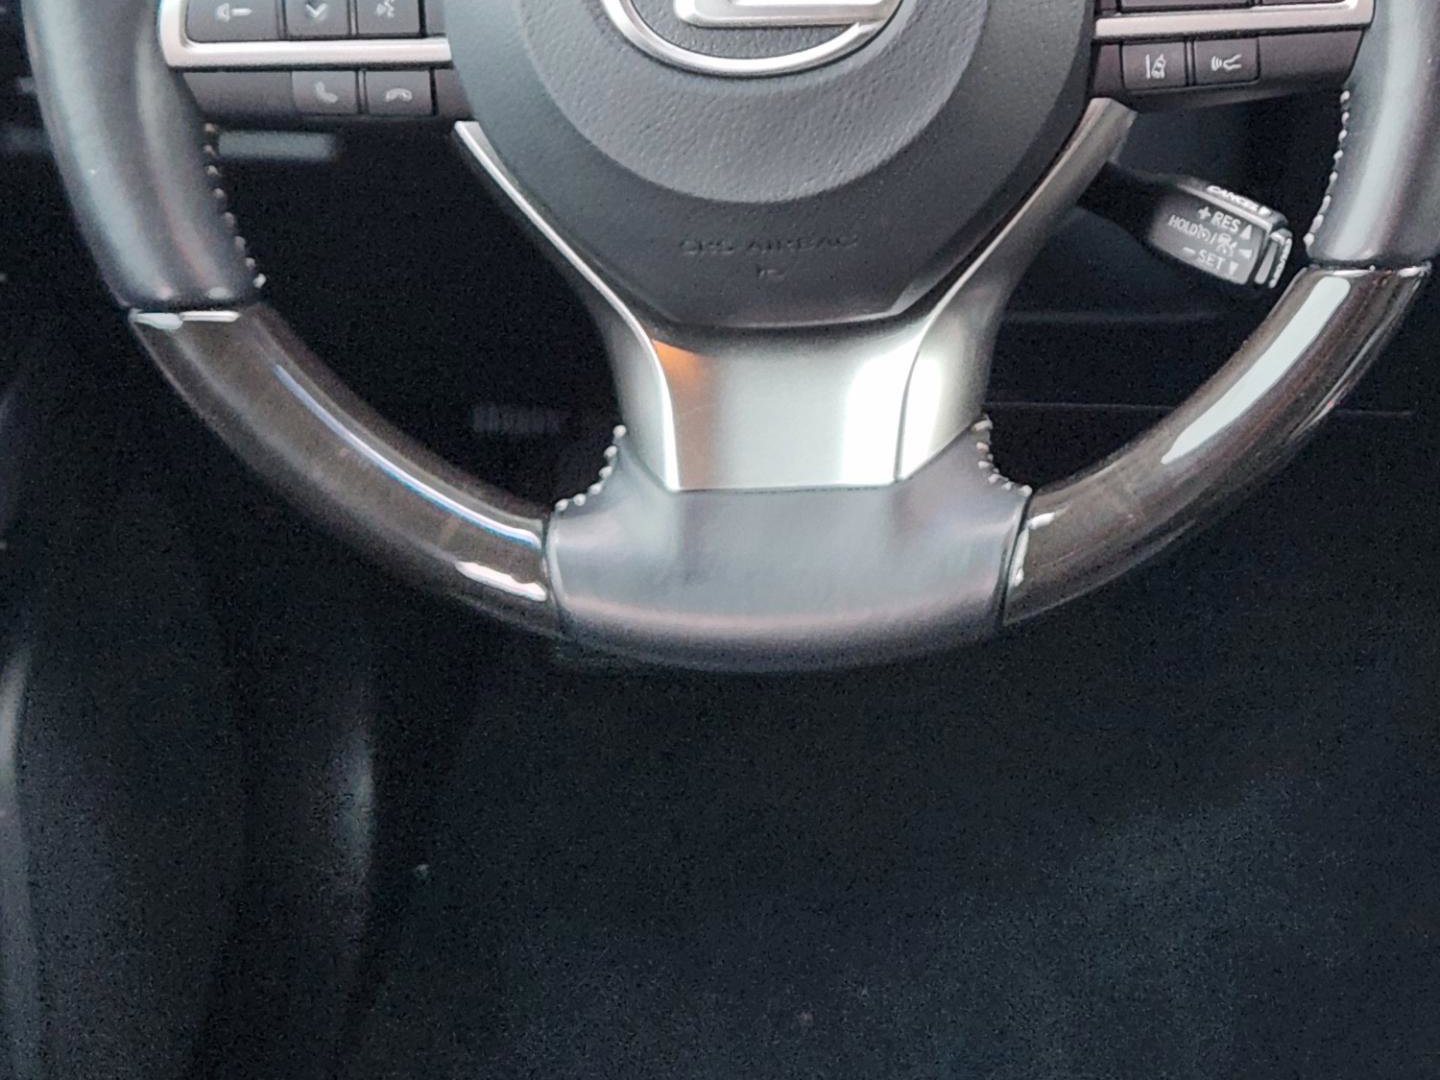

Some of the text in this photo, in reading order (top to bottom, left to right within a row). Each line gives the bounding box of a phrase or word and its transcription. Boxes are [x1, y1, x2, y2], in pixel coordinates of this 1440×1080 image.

[1167, 214, 1199, 236] HOLD
[1210, 210, 1242, 234] RES
[1198, 248, 1226, 270] SET
